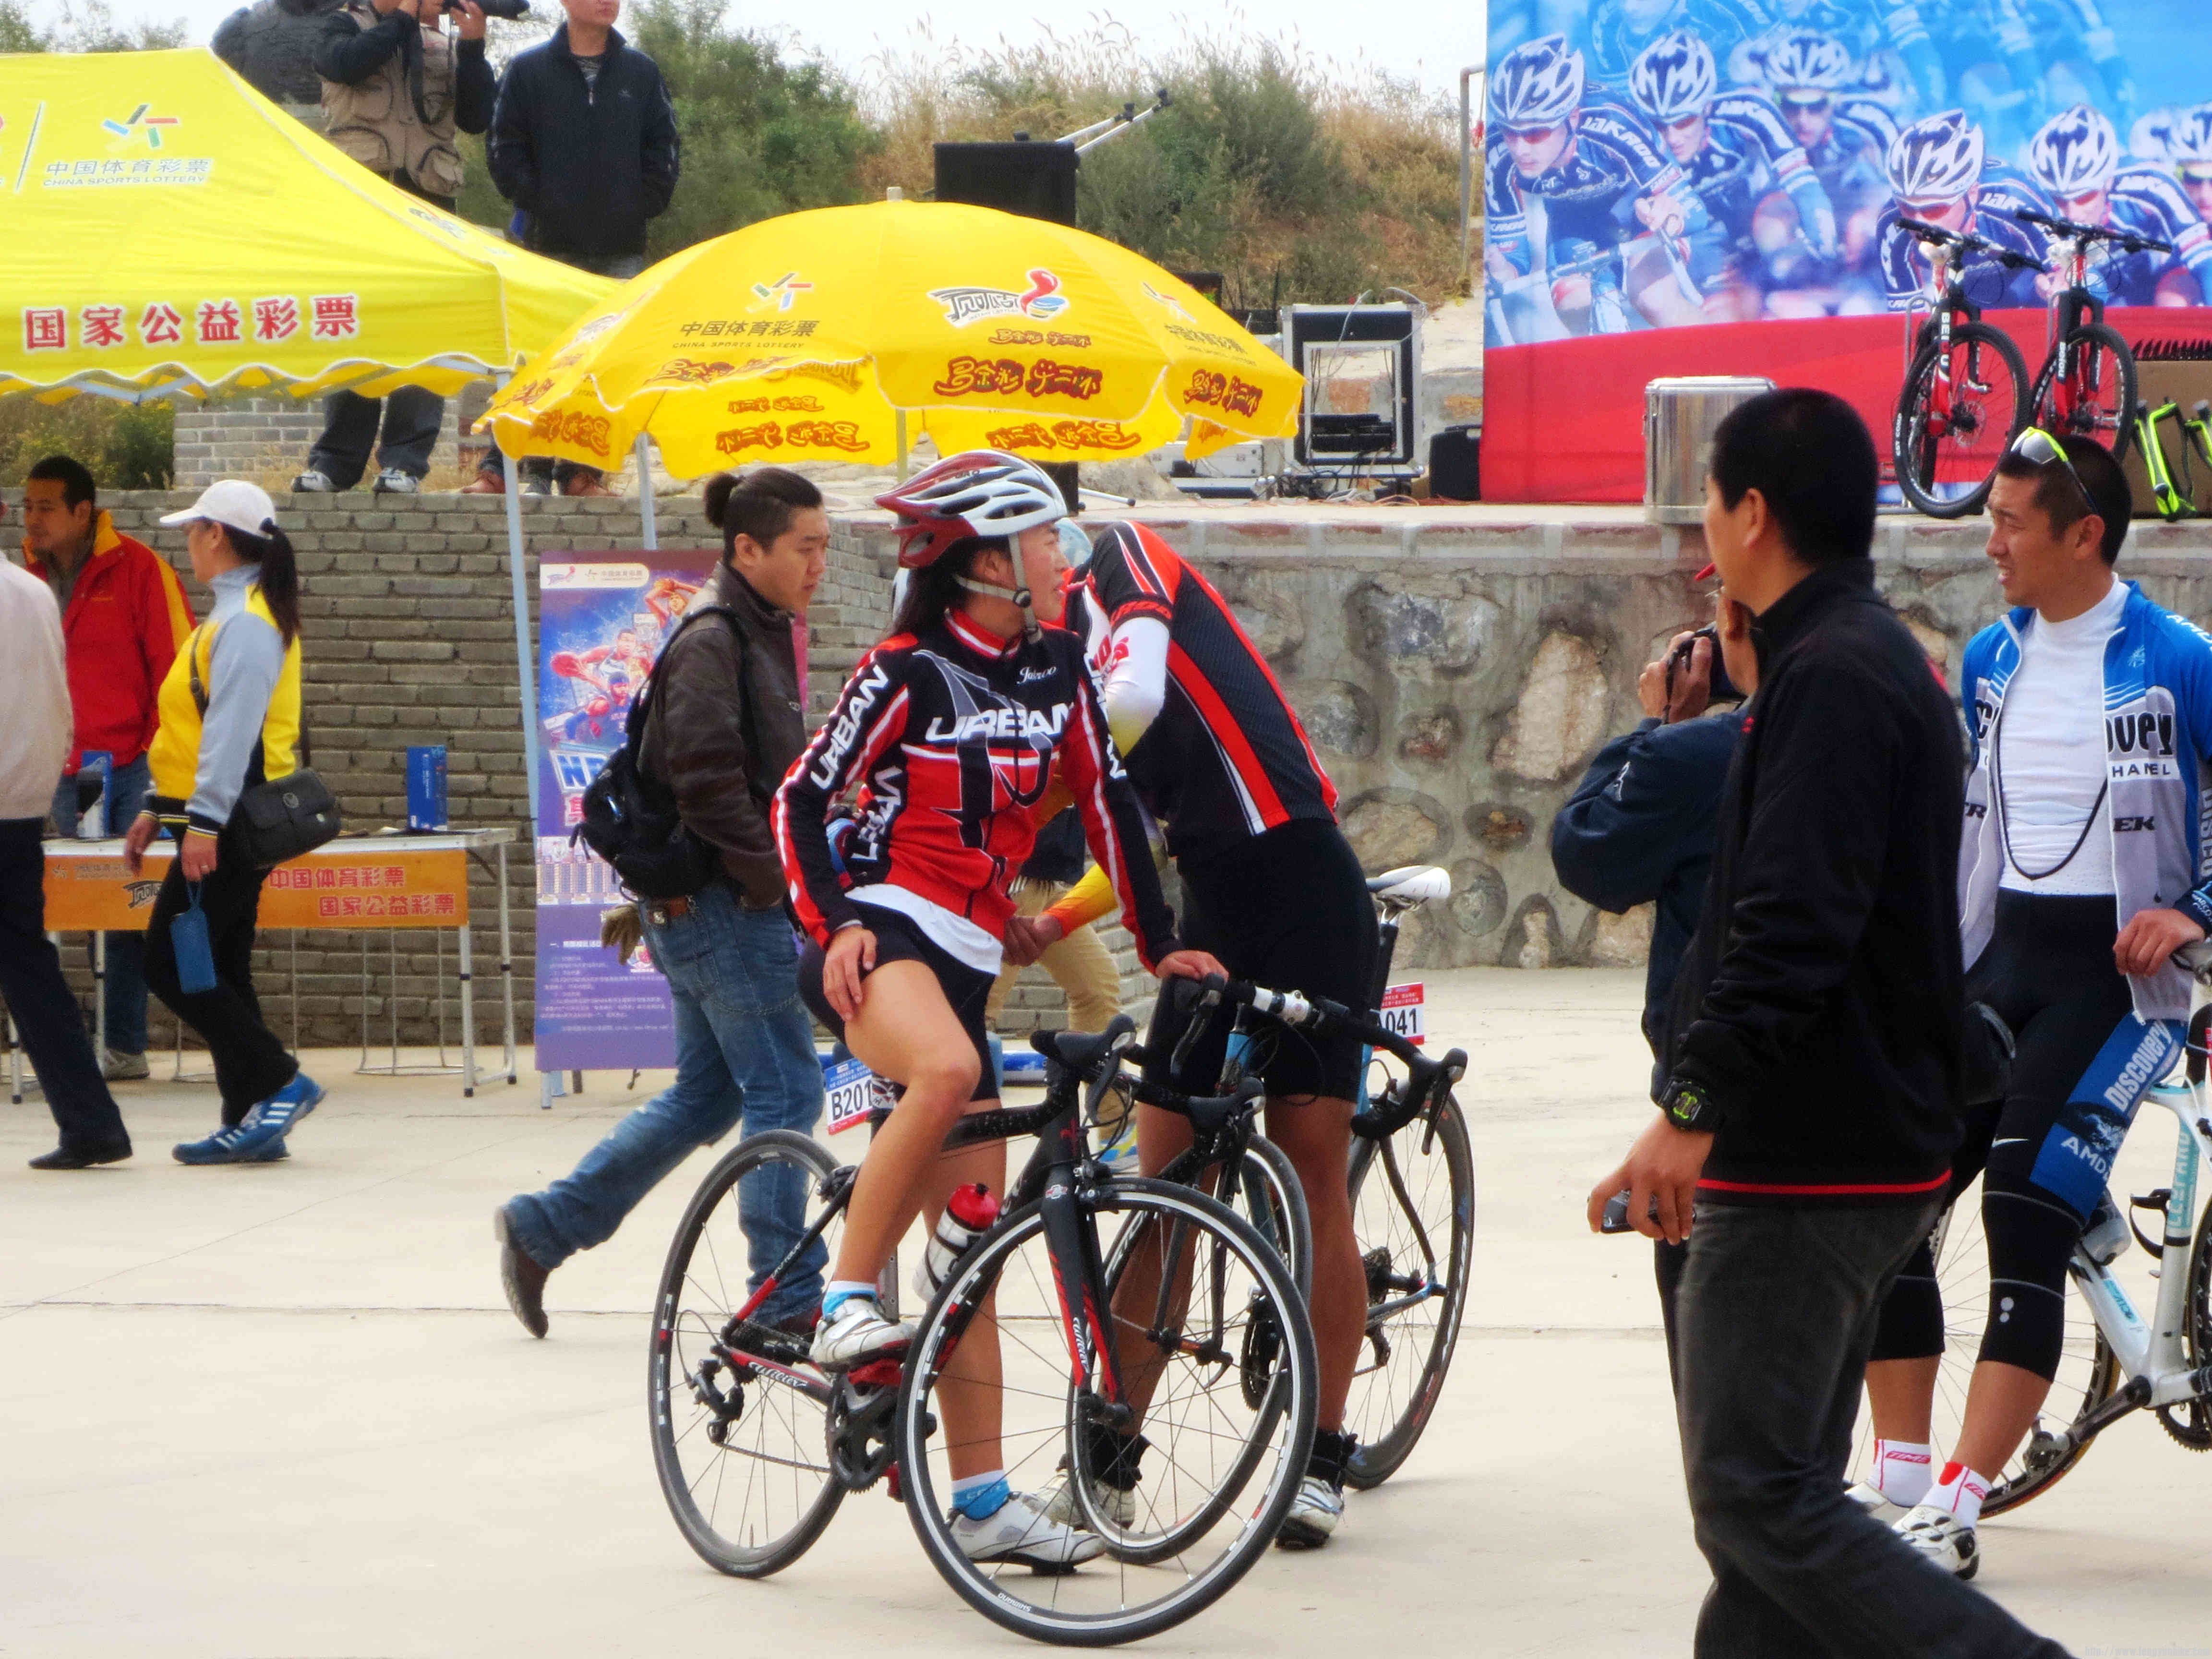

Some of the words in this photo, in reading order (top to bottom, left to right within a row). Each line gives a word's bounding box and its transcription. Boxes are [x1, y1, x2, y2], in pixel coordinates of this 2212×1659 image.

[47, 159, 210, 176] 中国体育彩票
[87, 177, 140, 185] SPORTS
[25, 295, 356, 349] 国家公益彩票
[680, 320, 820, 337] 中国体育彩票
[811, 664, 889, 790] URBAN
[925, 700, 1074, 744] URBAN
[270, 866, 405, 889] 中国体育彩票
[319, 894, 455, 916] 国家公益彩票
